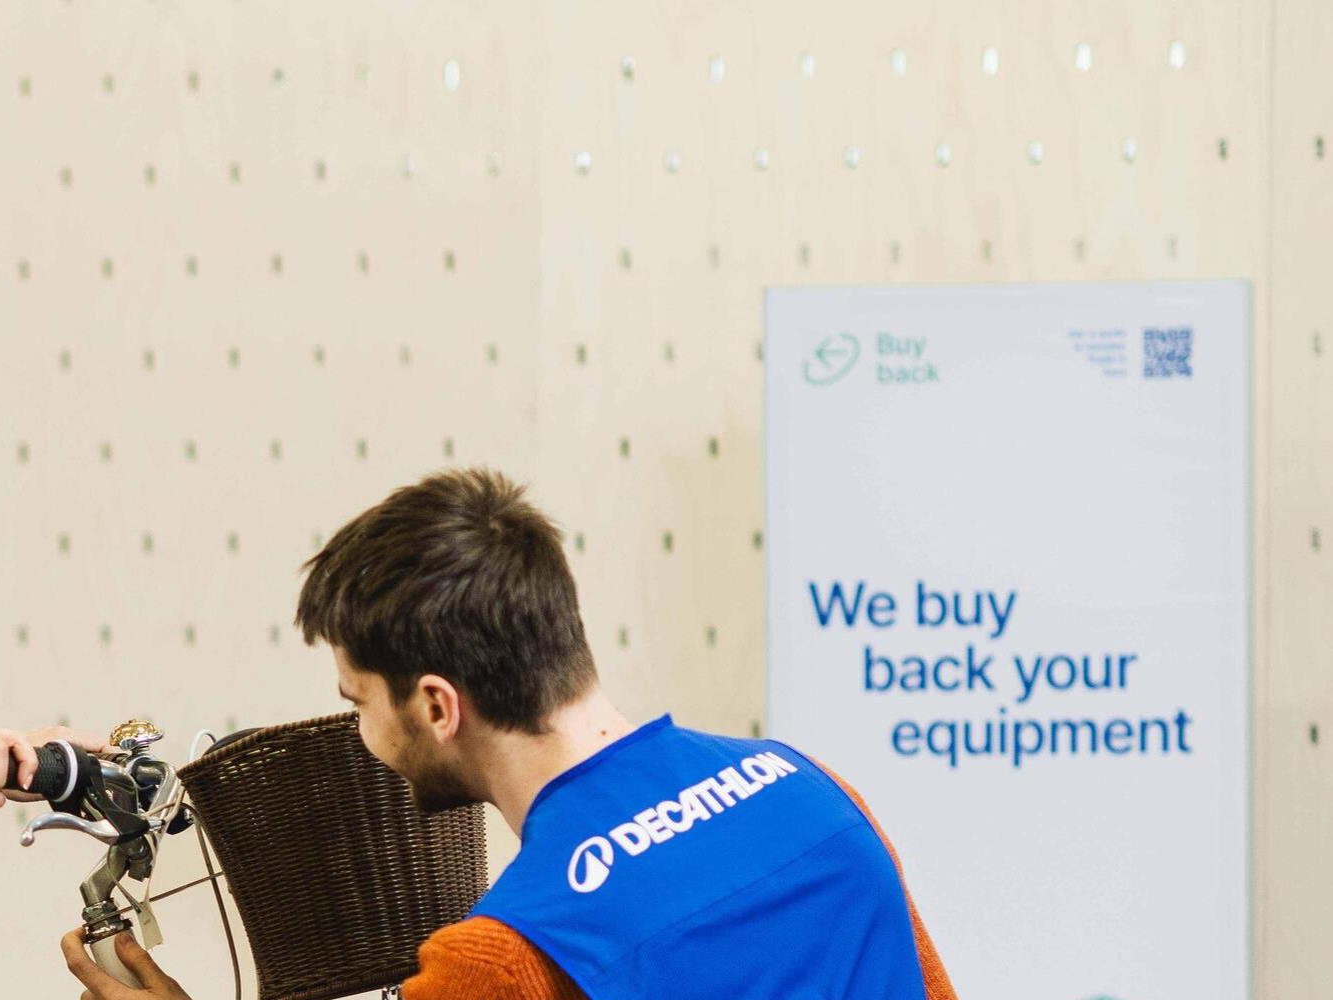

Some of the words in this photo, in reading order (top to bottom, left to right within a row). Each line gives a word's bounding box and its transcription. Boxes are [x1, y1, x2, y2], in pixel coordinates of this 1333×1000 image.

[875, 331, 927, 357] Buy
[875, 361, 940, 383] back
[809, 581, 897, 628] We
[916, 581, 1017, 639] buy
[864, 645, 994, 691] back
[1013, 653, 1137, 704] your
[891, 706, 1193, 767] equipment
[608, 751, 798, 857] DECATHLON
